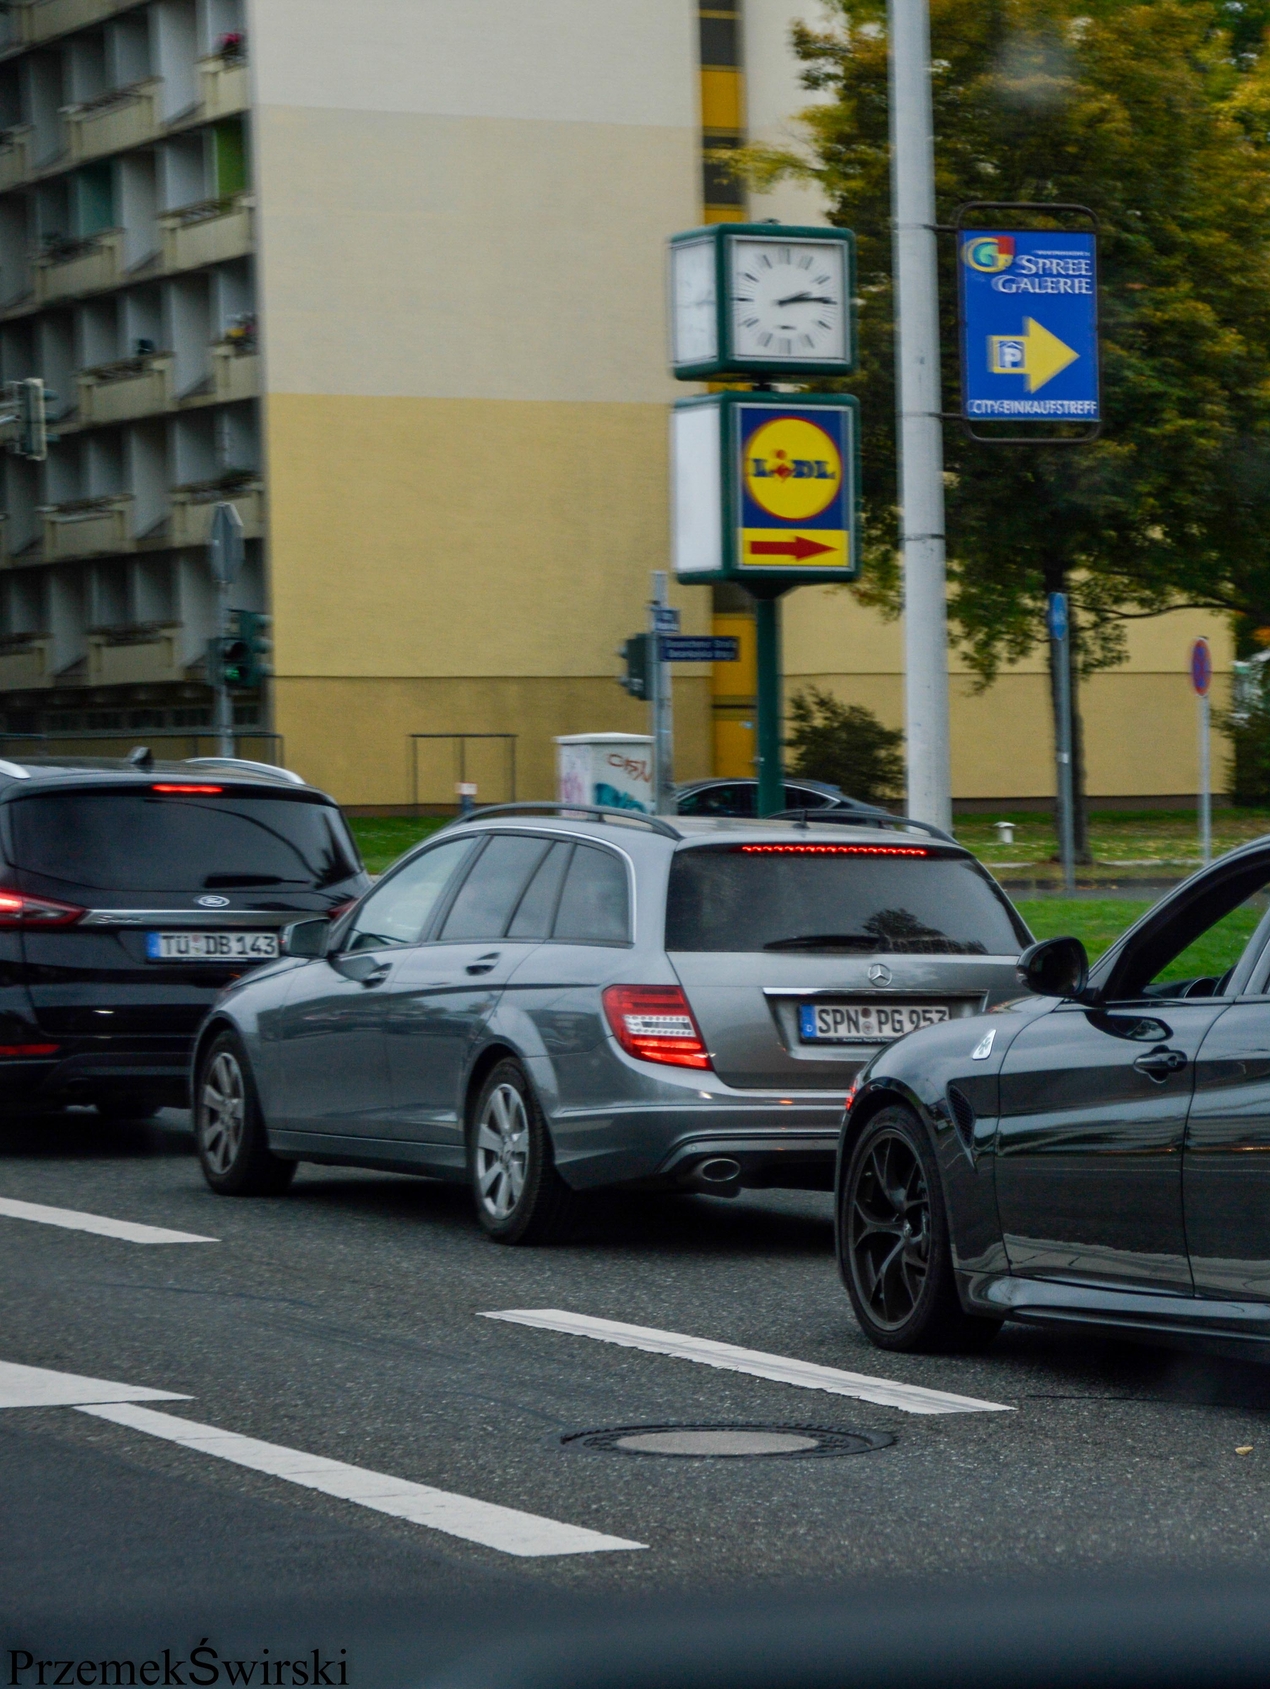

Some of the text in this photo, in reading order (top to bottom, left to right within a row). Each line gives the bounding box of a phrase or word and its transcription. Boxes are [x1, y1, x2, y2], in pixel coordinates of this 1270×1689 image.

[1017, 255, 1092, 275] SPREE
[994, 275, 1092, 294] GALERIE
[969, 400, 1097, 414] CITY-EINKAUFSTREFF
[204, 936, 232, 955] DB
[236, 935, 276, 955] 143
[818, 1009, 860, 1034] SPN
[876, 1010, 904, 1033] PG
